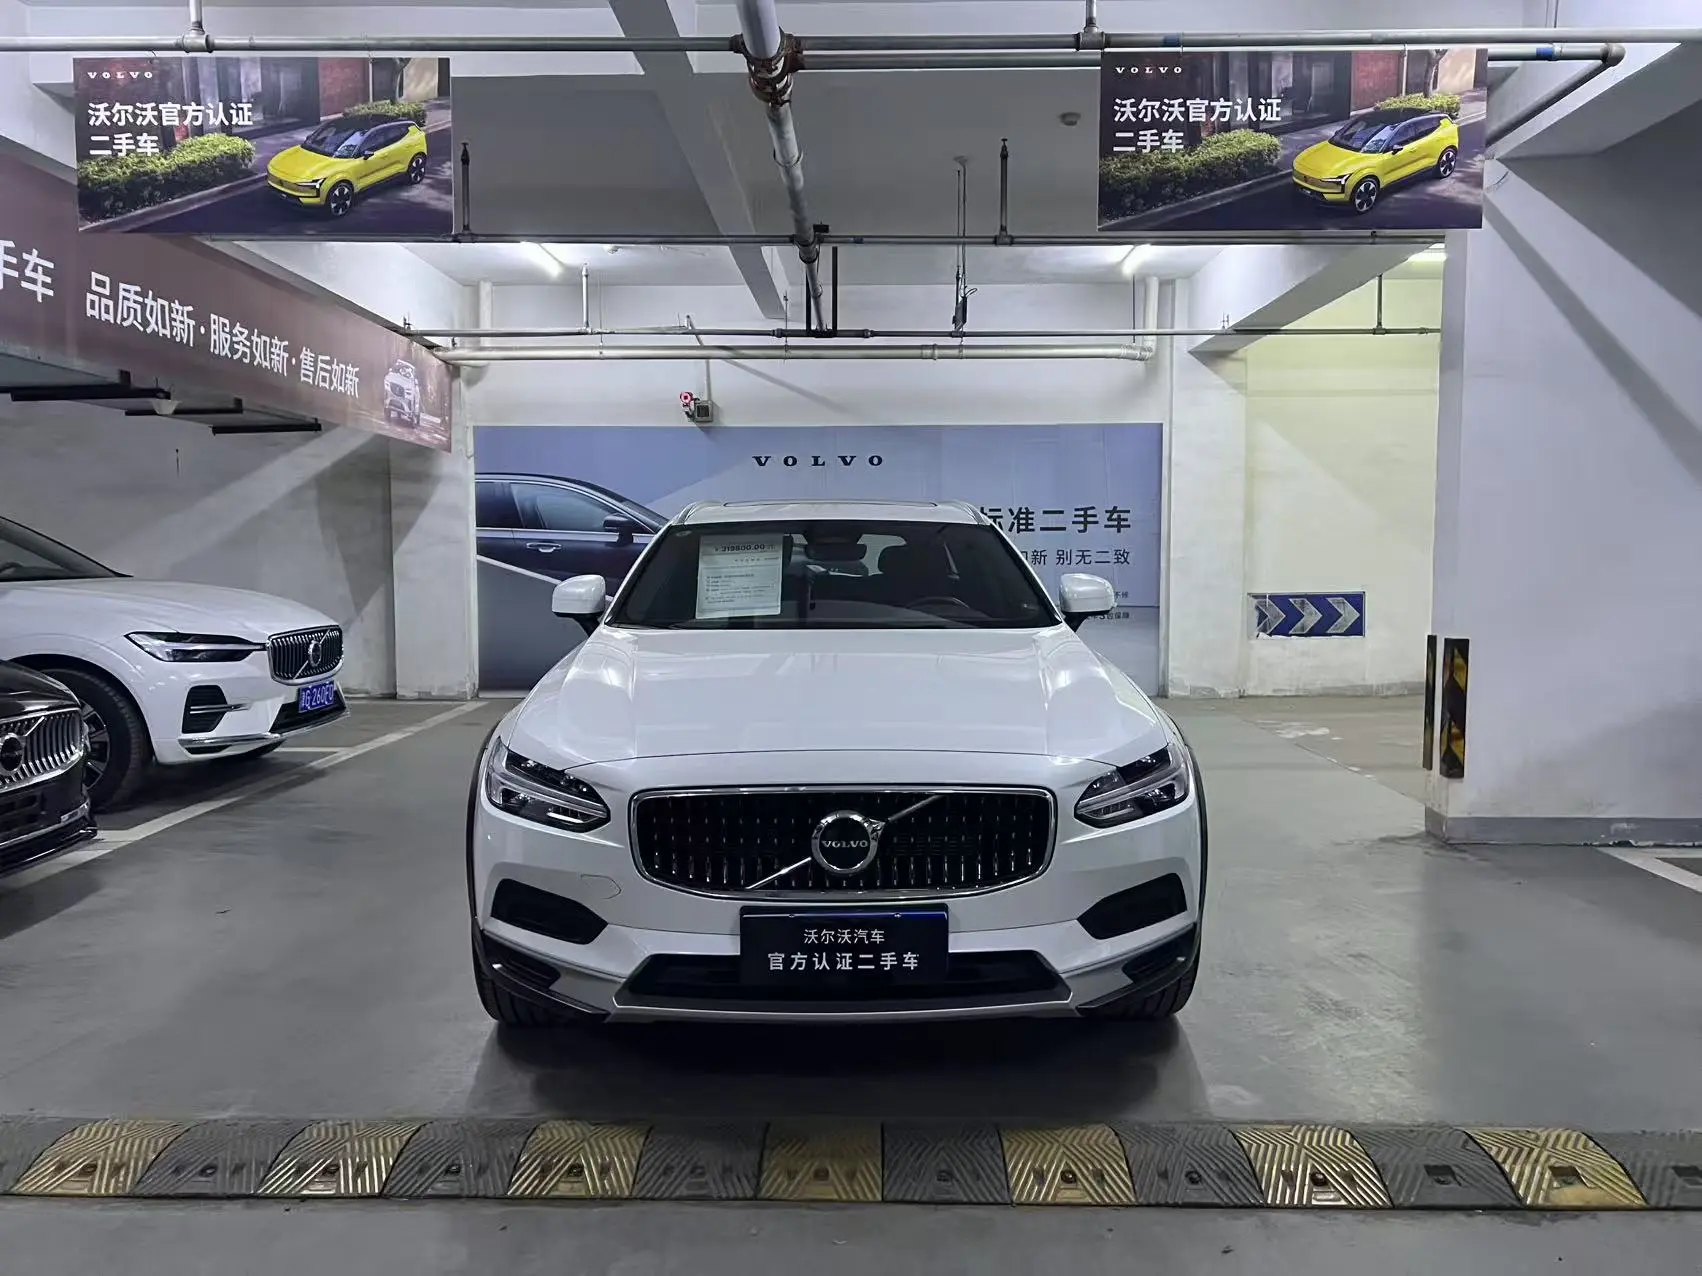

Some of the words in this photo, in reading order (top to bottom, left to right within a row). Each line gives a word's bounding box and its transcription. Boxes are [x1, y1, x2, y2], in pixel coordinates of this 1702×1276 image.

[87, 71, 153, 79] VOLVO
[1115, 66, 1182, 74] VOLVO
[87, 102, 254, 126] 沃尔沃官方认证
[1113, 97, 1282, 122] 沃尔沃官方认证
[89, 133, 160, 157] 二手车
[1113, 129, 1185, 154] 二手车
[752, 455, 883, 467] VOLVO
[1055, 549, 1131, 566] 别无二致
[821, 839, 869, 849] VOLVO
[803, 928, 885, 945] 沃尔沃汽车
[767, 951, 920, 971] 官方认证二手车
